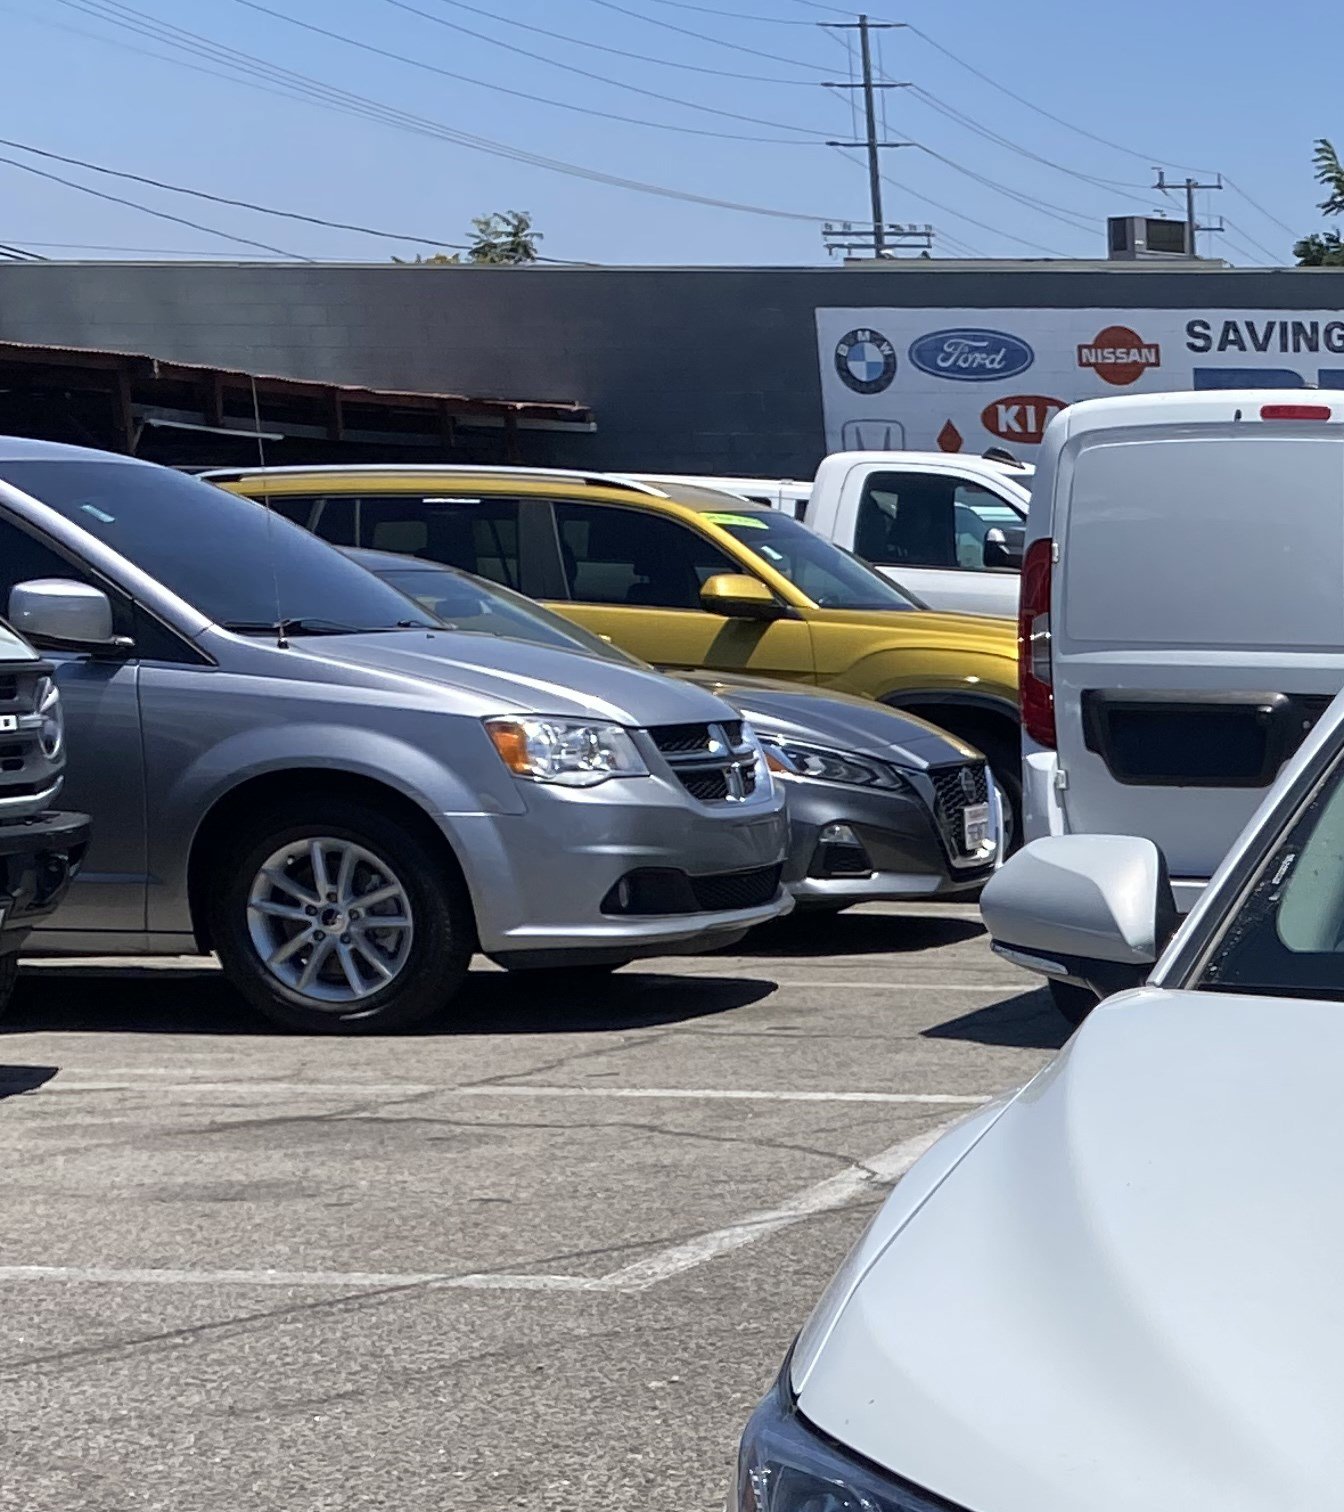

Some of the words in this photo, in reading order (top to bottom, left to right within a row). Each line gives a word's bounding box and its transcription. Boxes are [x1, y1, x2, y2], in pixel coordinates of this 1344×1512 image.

[936, 338, 1007, 370] Ford
[1081, 347, 1159, 365] NISSAN
[998, 403, 1056, 435] KI
